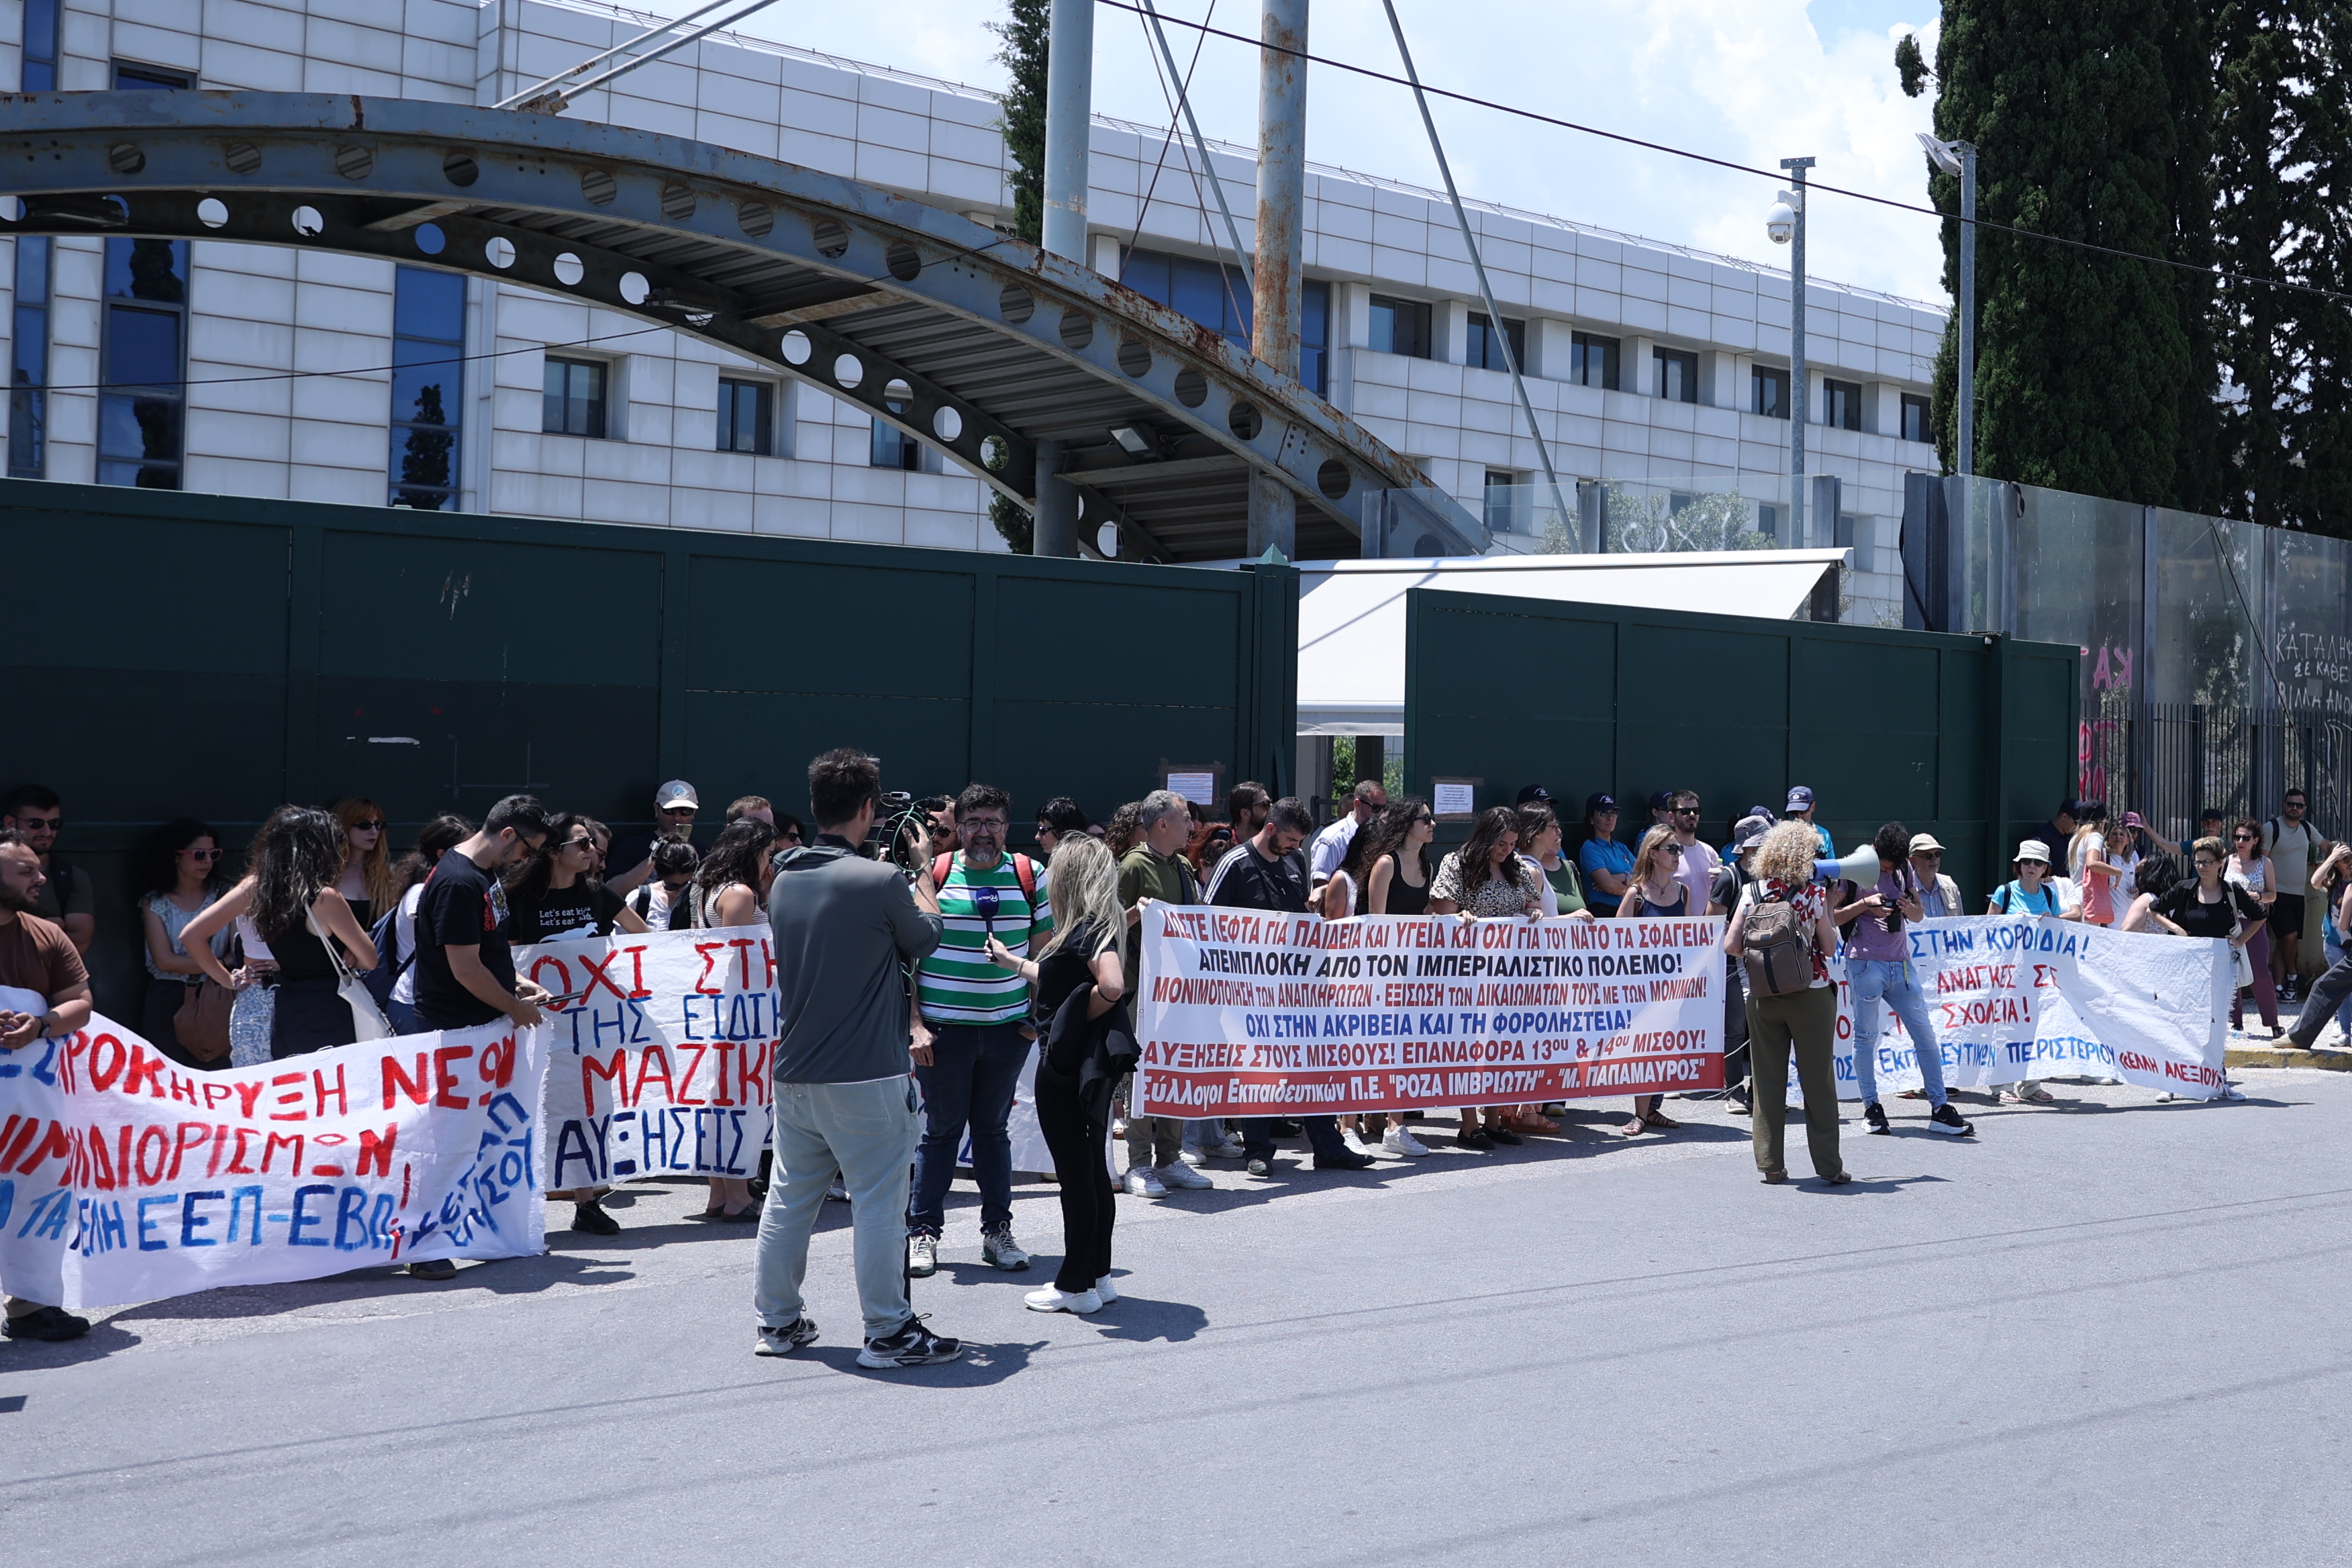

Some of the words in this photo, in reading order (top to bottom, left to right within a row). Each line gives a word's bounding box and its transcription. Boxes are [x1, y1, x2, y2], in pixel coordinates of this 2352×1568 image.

[539, 909, 560, 918] Let's
[540, 918, 560, 926] Let's
[1162, 910, 1208, 942] ΔΩΣΤΕ
[1211, 914, 1261, 944] ΛΕΦΤΑ
[1266, 921, 1288, 945] ΓΙΑ
[1293, 920, 1362, 950] ΠΑΙΔΕΙΑ
[1365, 924, 1389, 948] ΚΑΙ
[1396, 922, 1445, 949] ΥΓΕΙΑ
[1452, 923, 1478, 949] ΚΑΙ
[1482, 923, 1512, 950] ΟΧΙ
[1518, 927, 1540, 950] ΓΙΑ
[1545, 928, 1567, 950] ΤΟΥ
[1571, 924, 1610, 950] ΝΑΤΟ
[1615, 927, 1634, 950] ΤΑ
[1638, 922, 1714, 948] ΣΦΑΓΕΙΑ!
[1909, 928, 1973, 959] ΣΤΗΝ
[1986, 924, 2089, 961] ΚΟΡΟΙΔΙΑ!
[530, 944, 652, 1012] ΟΧΙ
[1199, 948, 1312, 977] ΑΠΕΜΠΛΟΚΗ
[1316, 957, 1361, 978] ΑΠΟ
[1367, 954, 1408, 977] ΤΟΝ
[1416, 955, 1583, 977] ΙΜΠΕΡΙΑΛΙΣΤΙΚΟ
[1588, 953, 1682, 975] ΠΟΛΕΜΟ!
[1937, 965, 2016, 995] ΑΝΑΓΚΕΣ
[2032, 964, 2062, 989] ΣΕ
[1152, 976, 1253, 1007] ΜΟΝΙΜΟΠΟΙΗΣΗ
[1256, 986, 1274, 1008] ΤΩΝ
[1278, 983, 1373, 1008] ΑΝΑΠΛΗΡΩΤΩΝ
[1385, 983, 1444, 1007] ΕΞΙΣΩΣΗ
[1449, 987, 1473, 1006] ΤΩΝ
[1477, 983, 1569, 1007] ΔΙΚΑΙΩΜΑΤΩΝ
[1572, 983, 1600, 1006] ΤΟΥΣ
[1603, 987, 1620, 1004] ΜΕ
[1622, 984, 1647, 1004] ΤΩΝ
[1649, 977, 1708, 1003] ΜΟΝΙΜΩΝ!
[561, 996, 652, 1055] ΤΗΣ
[1246, 1014, 1270, 1038] ΟΧΙ
[1274, 1014, 1317, 1038] ΣΤΗΝ
[1322, 1014, 1413, 1038] ΑΚΡΙΒΕΙΑ
[1419, 1013, 1453, 1035] ΚΑΙ
[1460, 1013, 1487, 1035] ΤΗ
[1493, 1010, 1632, 1034] ΦΟΡΟΛΗΣΤΕΙΑ!
[1941, 996, 2030, 1029] ΣΧΟΛΕΙΑ!
[1144, 1040, 1247, 1069] ΑΥΞΗΣΕΙΣ
[1250, 1044, 1302, 1068] ΣΤΟΥΣ
[1307, 1043, 1395, 1067] ΜΙΣΘΟΥΣ!
[1402, 1040, 1525, 1065] ΕΠΑΝΑΦΟΡΑ
[1575, 1038, 1589, 1059] &
[1632, 1030, 1706, 1054] ΜΙΣΘΟΥ!
[1877, 1042, 1996, 1073] ΕΚΠΕΥΤΙΚΩΝ
[2006, 1036, 2115, 1067] ΠΕΡΙΣΤΕΡΙΟΥ
[381, 1032, 516, 1110] ΝΕΩΝ
[1142, 1074, 1224, 1112] Σύλλογοι
[1227, 1075, 1346, 1105] Εκπαιδευτικών
[1350, 1075, 1385, 1101] Π.Ε.
[1389, 1075, 1444, 1099] "ΡΟΖΑ
[1448, 1069, 1545, 1097] ΙΜΒΡΙΩΤΗ"
[1558, 1066, 1582, 1090] "Μ.
[1585, 1057, 1706, 1088] ΠΑΠΑΜΑΥΡΟΣ"
[555, 1108, 746, 1188] ΑΥΞΗΣΕΙΣ
[69, 1197, 128, 1257] ΕΛΗ
